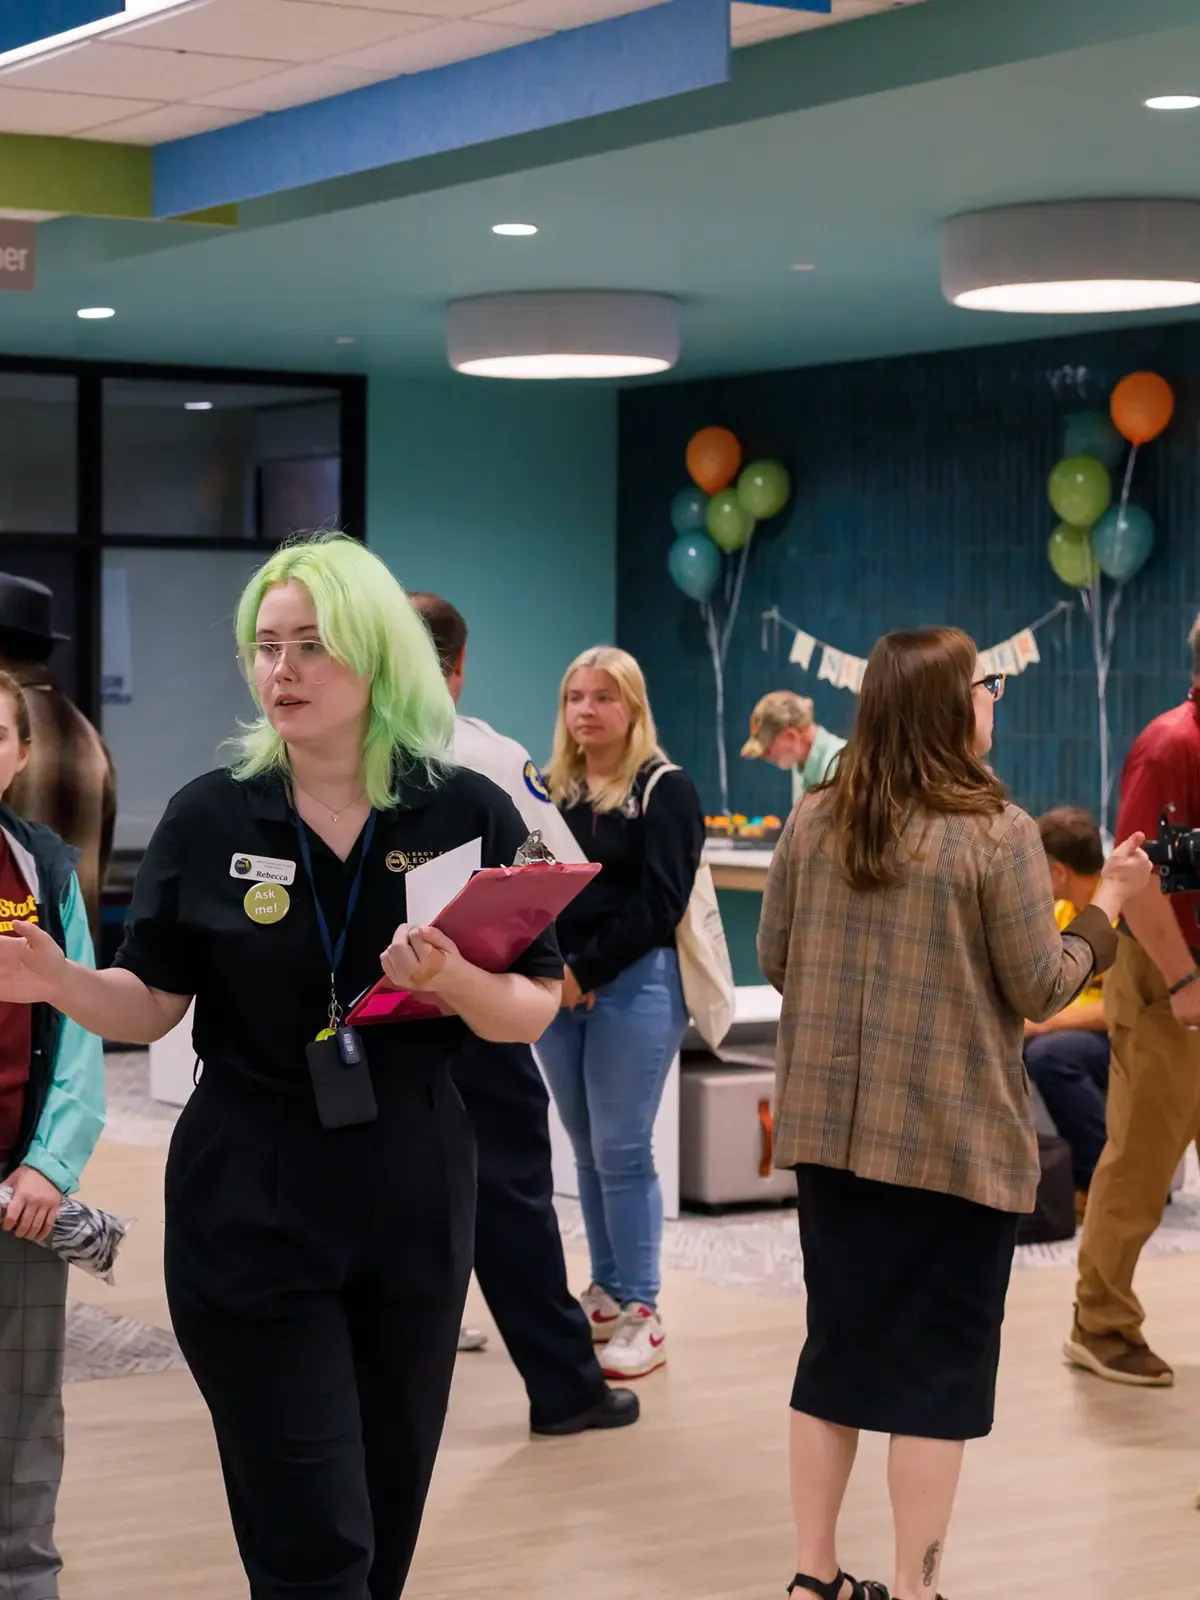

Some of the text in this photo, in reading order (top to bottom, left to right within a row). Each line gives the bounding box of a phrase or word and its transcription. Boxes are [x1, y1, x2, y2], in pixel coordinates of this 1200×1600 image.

[256, 870, 288, 881] Rebecca
[255, 888, 276, 901] Ask
[255, 902, 278, 915] me!
